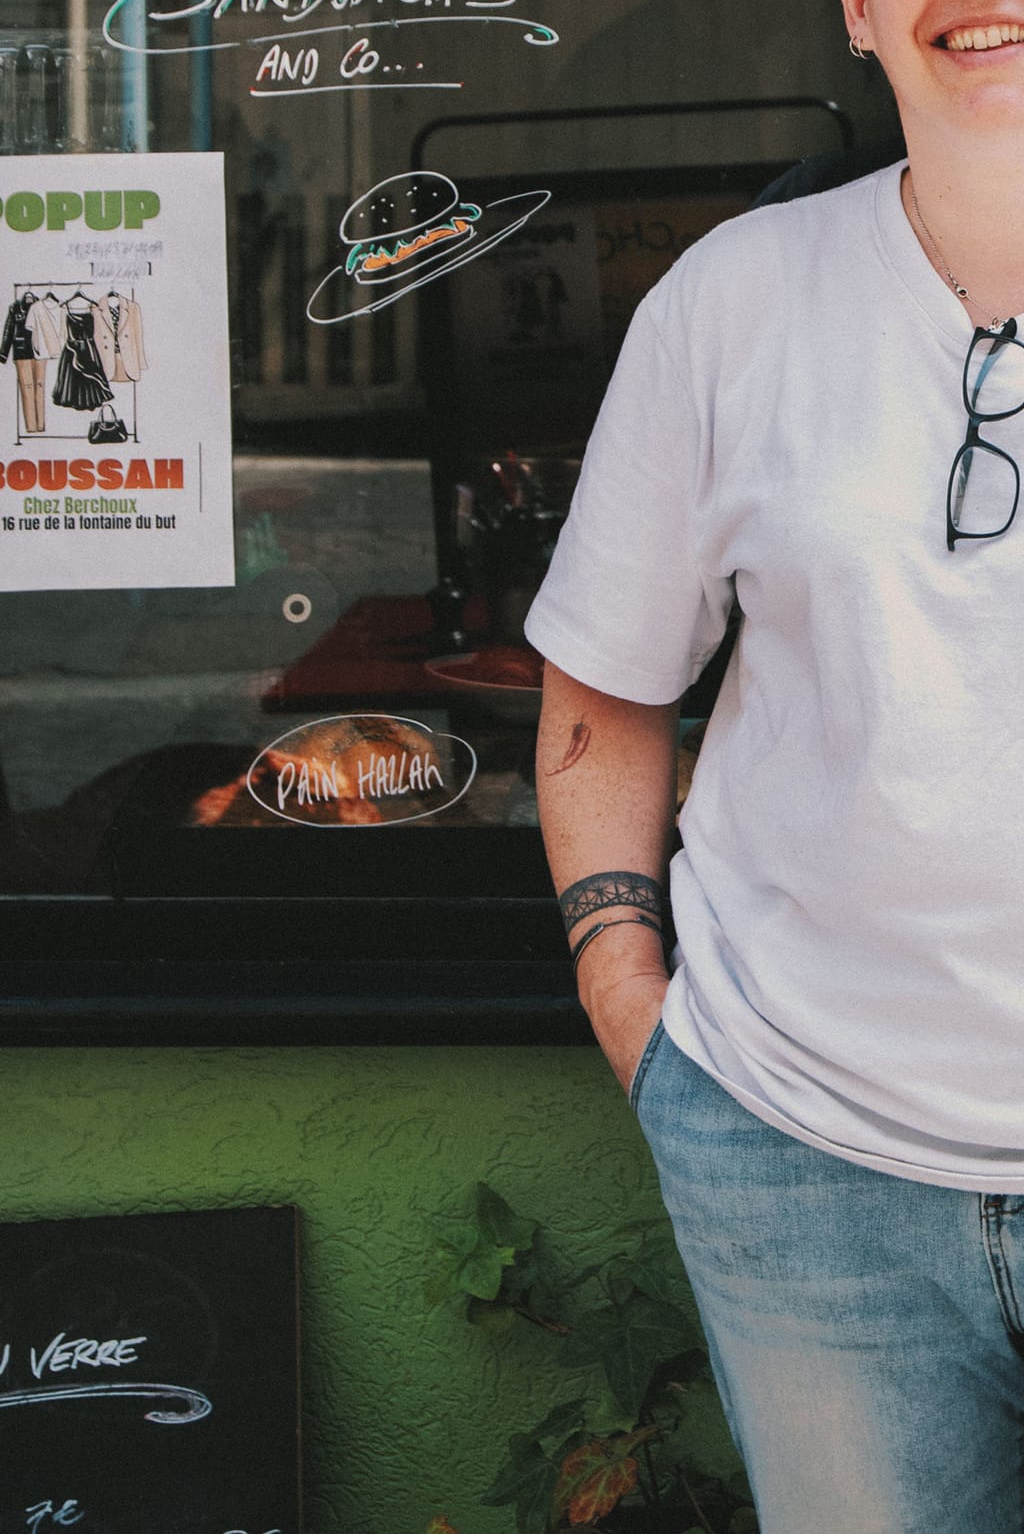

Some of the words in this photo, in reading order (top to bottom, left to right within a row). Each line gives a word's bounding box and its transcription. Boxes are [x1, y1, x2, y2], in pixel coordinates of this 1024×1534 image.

[255, 44, 320, 85] AND
[0, 190, 161, 233] OPUP
[0, 458, 184, 491] OUSSAH
[2, 516, 15, 531] 16
[19, 517, 40, 530] rue
[44, 516, 60, 530] de
[64, 516, 75, 530] la
[79, 514, 132, 530] fontaine
[136, 514, 151, 529] du
[155, 514, 176, 529] but
[23, 497, 60, 515] Chez
[64, 496, 137, 514] Berchoux
[30, 1332, 147, 1379] VERRE
